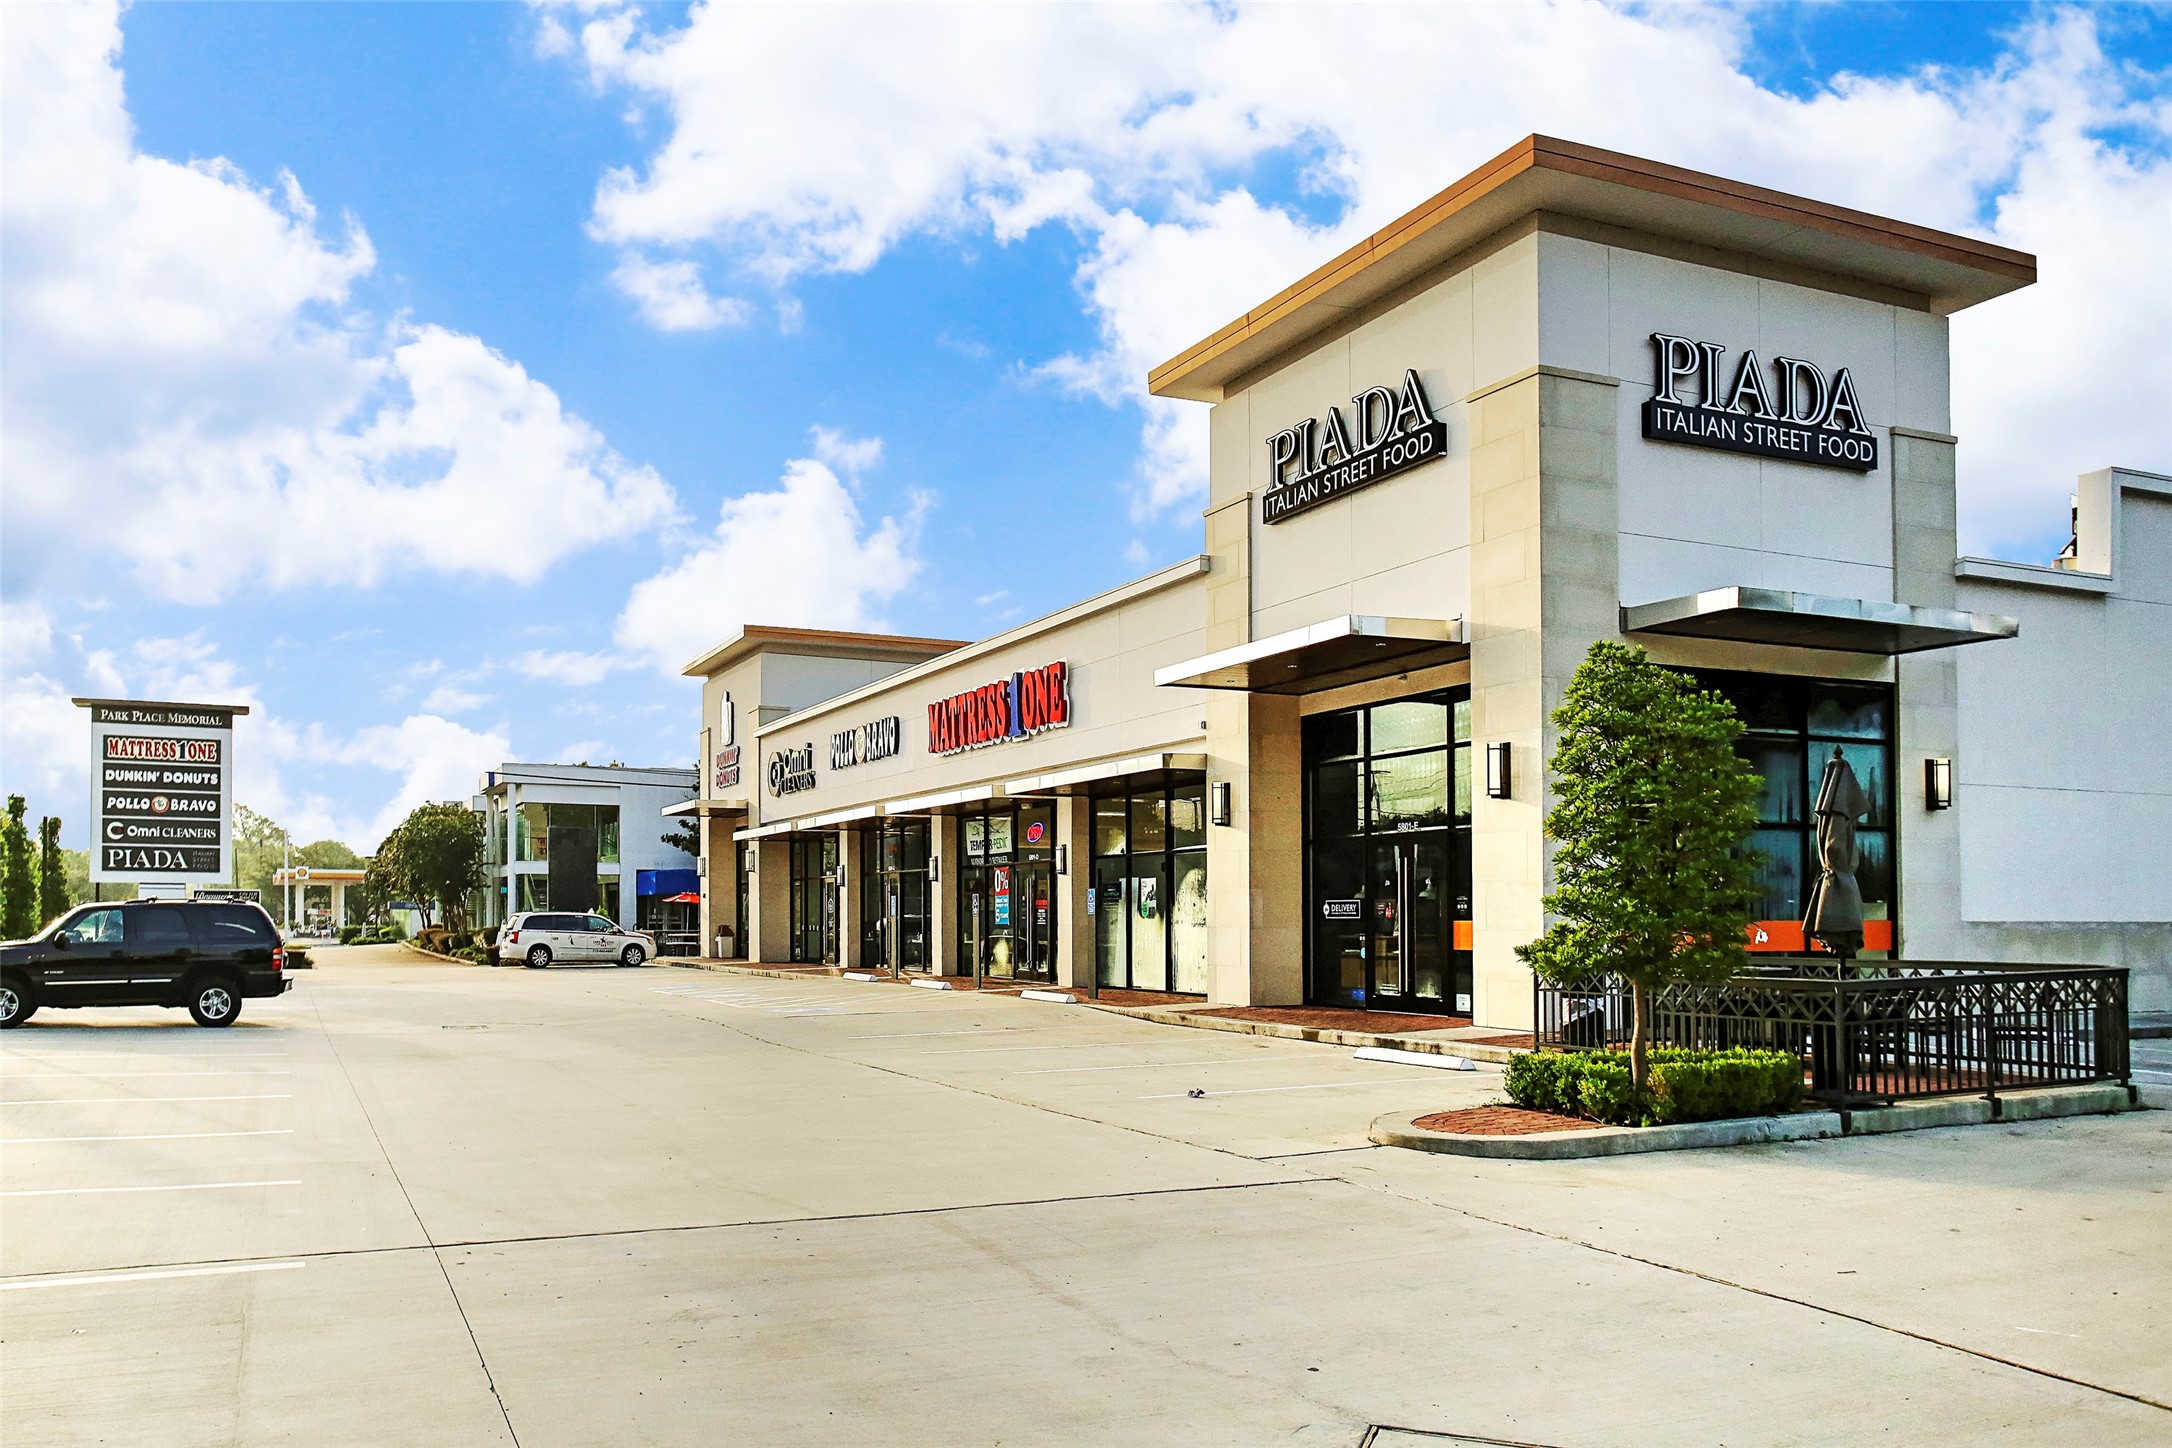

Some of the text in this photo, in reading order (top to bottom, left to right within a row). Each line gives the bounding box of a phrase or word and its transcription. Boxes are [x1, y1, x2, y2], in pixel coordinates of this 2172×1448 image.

[1649, 332, 1873, 437] PIADA
[1264, 368, 1434, 494] PIADA
[1656, 407, 1874, 462] ITALIAN STREET FOOD
[1265, 432, 1433, 518] ITALIAN STREET FOOD
[100, 709, 223, 726] PARK PLACE MEMORIAL
[830, 716, 900, 770] POLLO BRAVO
[163, 771, 218, 785] DONUTS
[716, 766, 739, 789] DONUTS
[106, 797, 217, 812] POLLO BRAVO
[126, 826, 160, 838] Omni
[162, 828, 217, 839] CLEANERS
[108, 849, 189, 869] PIADA
[994, 869, 1009, 892] 0%
[1331, 903, 1357, 912] DELIVERY
